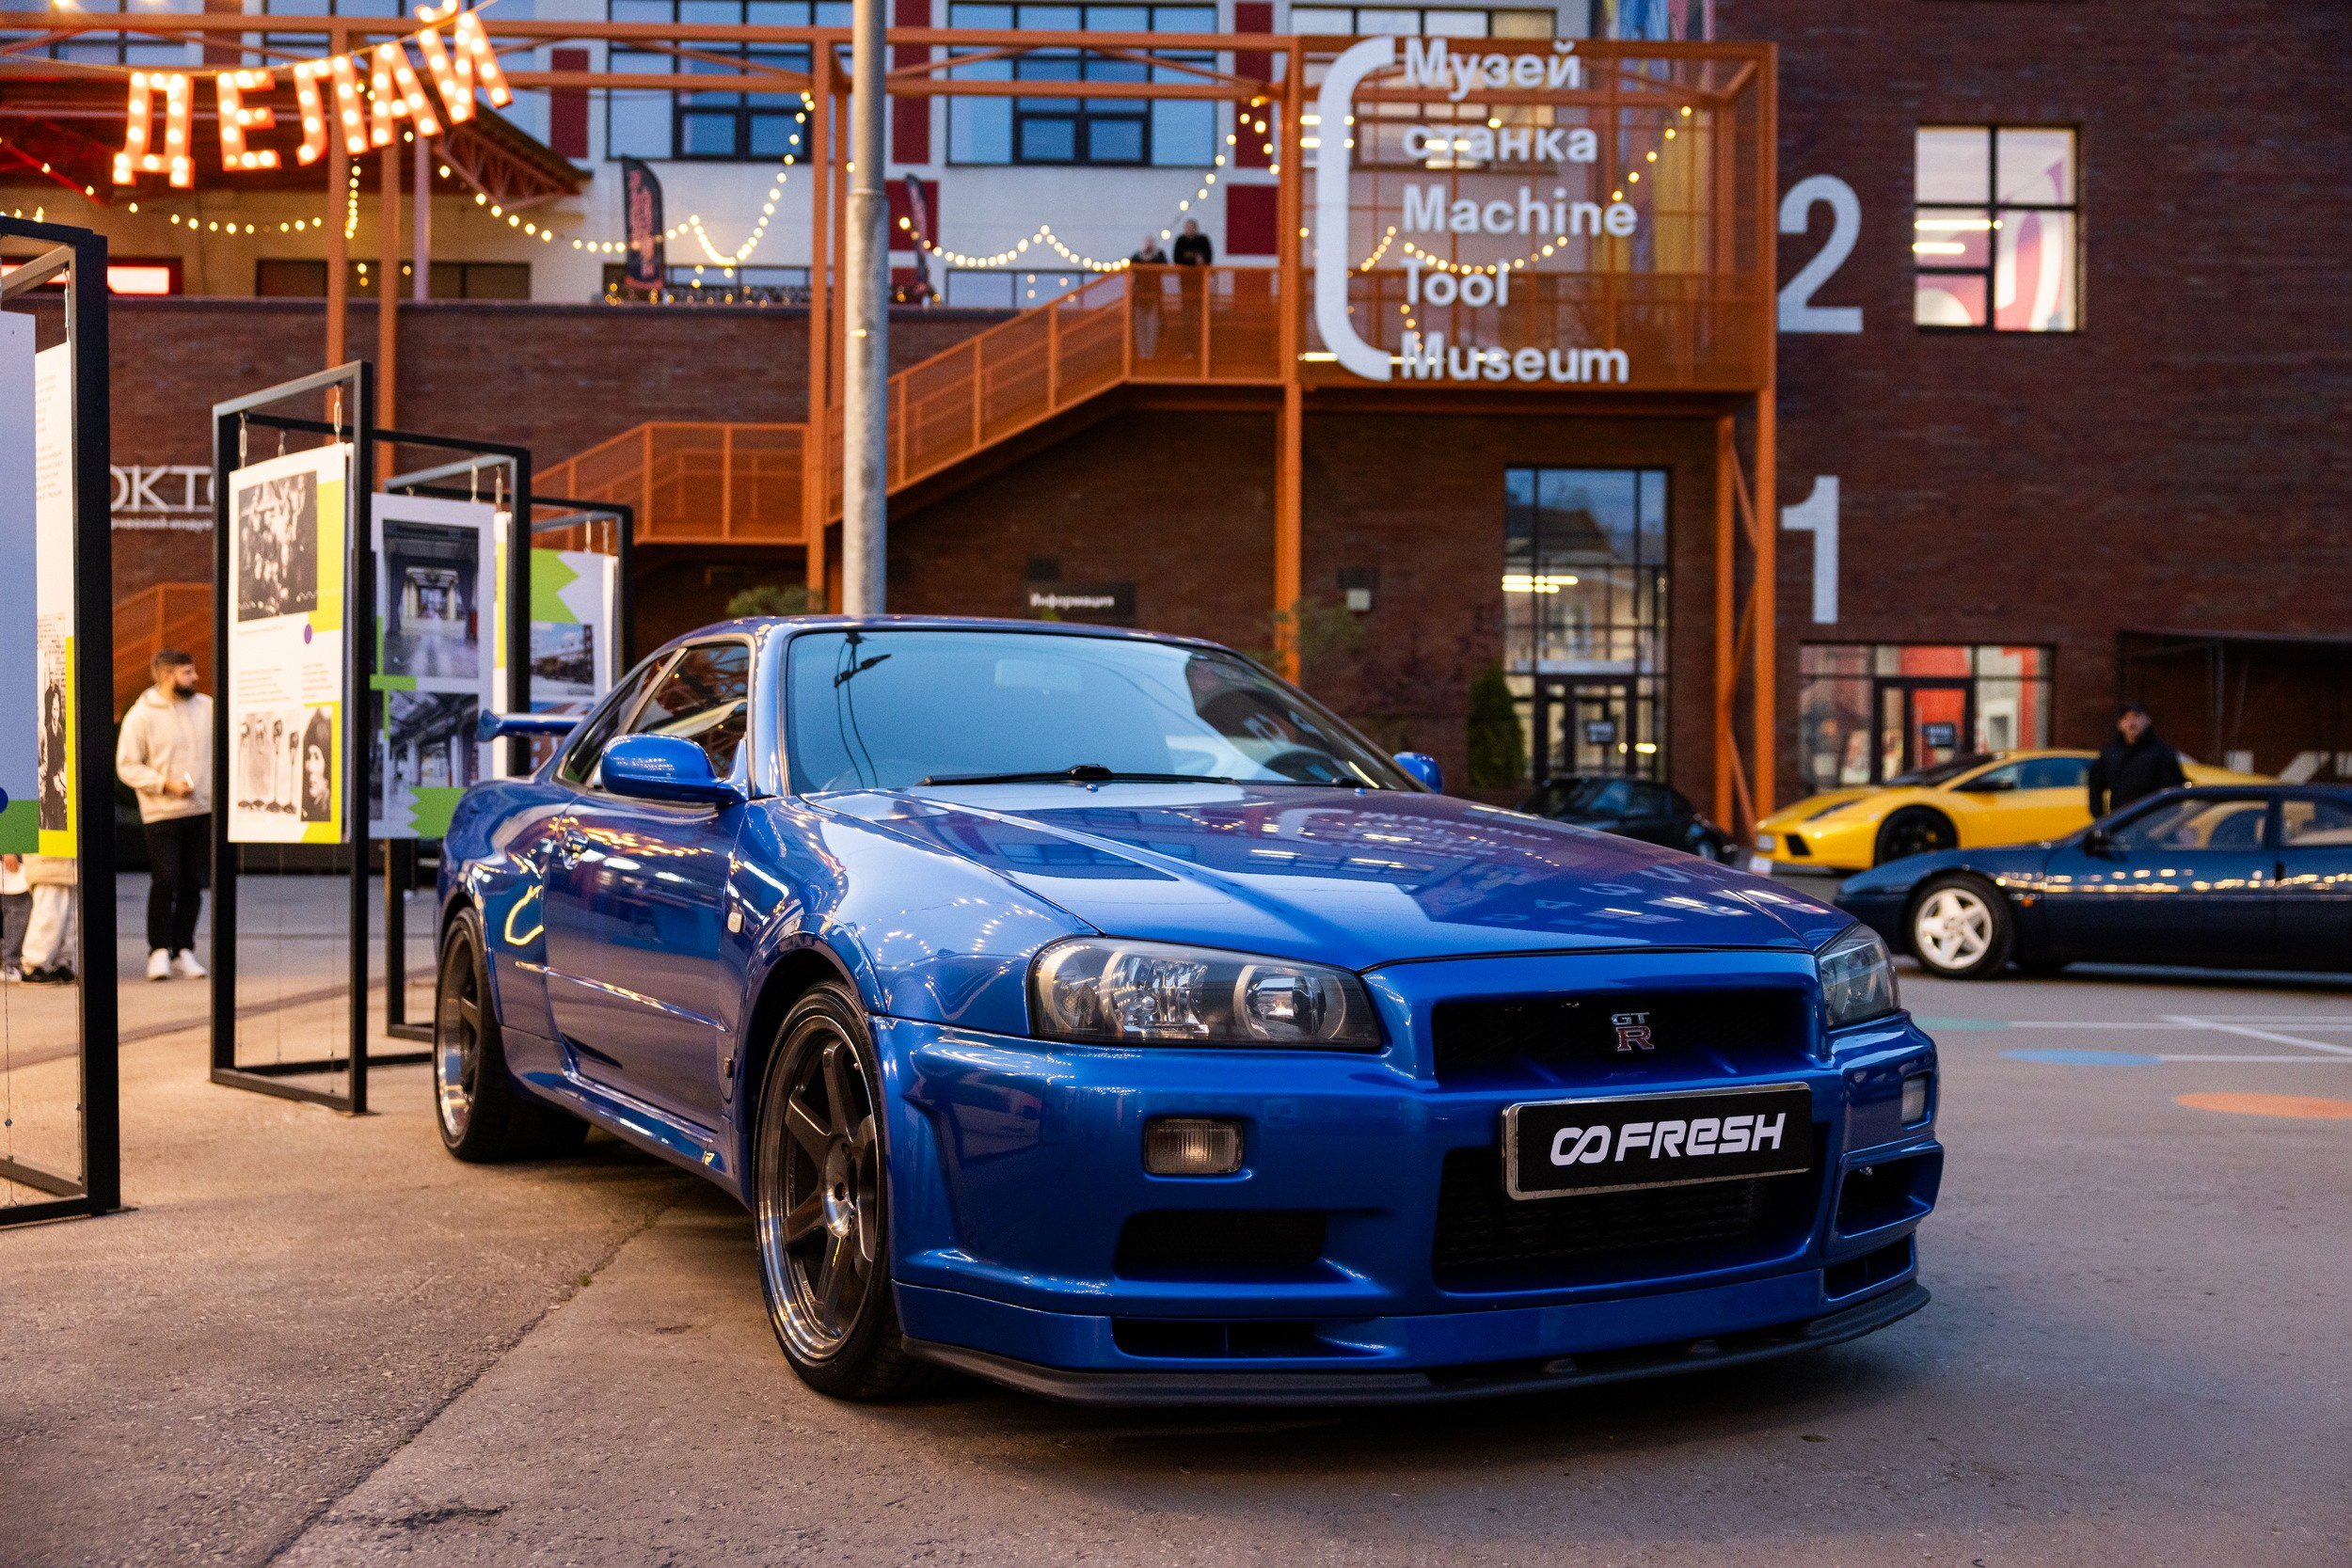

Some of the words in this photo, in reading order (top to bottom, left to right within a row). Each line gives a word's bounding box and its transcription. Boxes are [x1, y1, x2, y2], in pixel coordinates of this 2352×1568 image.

[112, 0, 513, 188] ДЕЛАЙ
[1404, 38, 1582, 102] Музей
[1402, 123, 1598, 163] станка
[1402, 183, 1639, 237] Machine
[1777, 173, 1864, 334] 2
[1399, 257, 1509, 308] Tool
[1400, 330, 1630, 384] Museum
[1781, 475, 1840, 625] 1
[1611, 1011, 1650, 1025] GT
[1615, 1025, 1655, 1052] R
